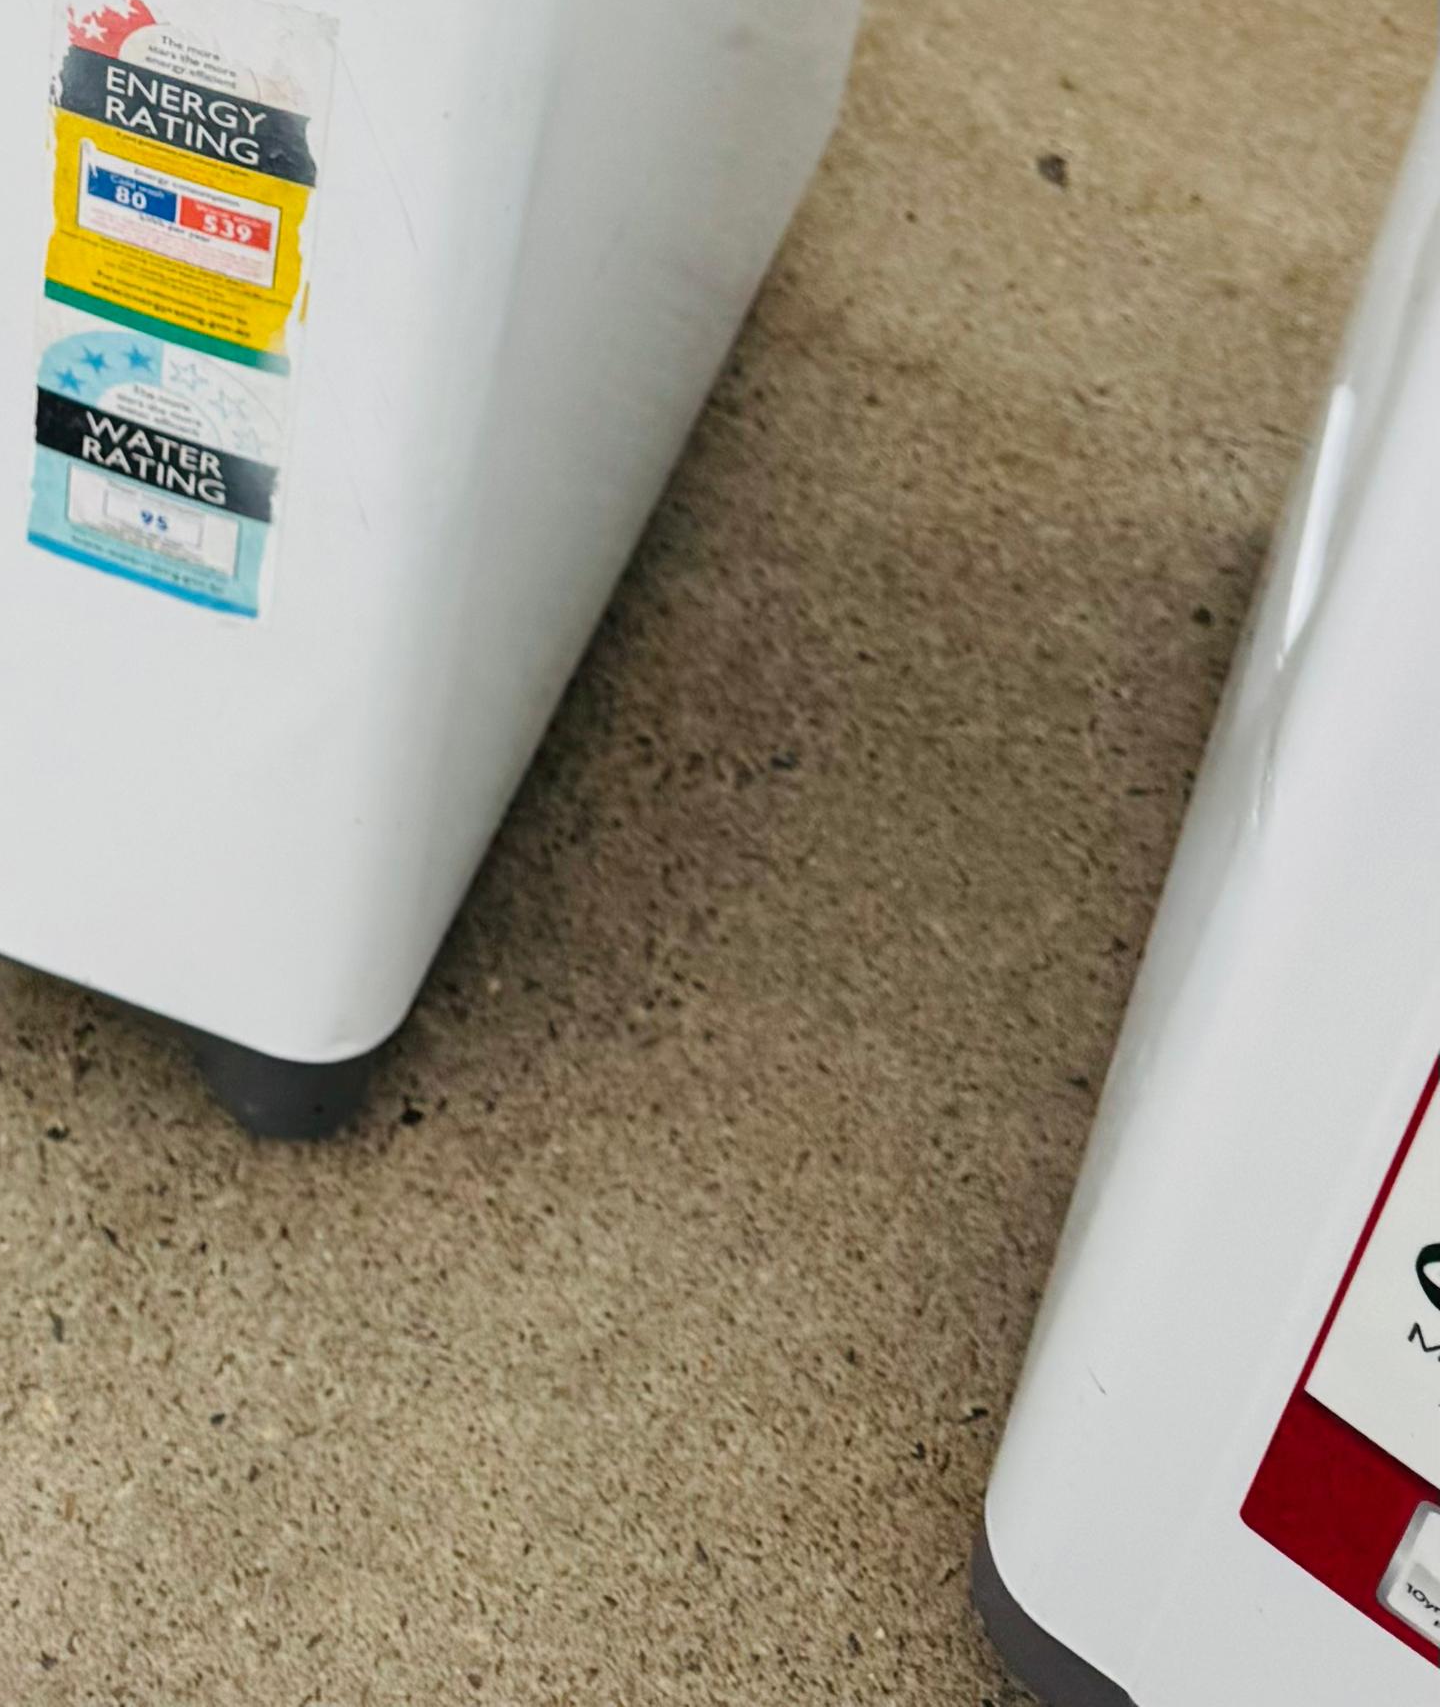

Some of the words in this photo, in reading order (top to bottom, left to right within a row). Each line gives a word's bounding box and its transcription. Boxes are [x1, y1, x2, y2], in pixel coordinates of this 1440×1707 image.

[161, 35, 183, 49] The
[105, 65, 267, 135] ENERGY
[105, 97, 260, 166] RATING
[115, 187, 148, 210] 80
[202, 215, 253, 243] 539
[81, 436, 226, 506] RATING
[86, 410, 224, 480] WATER
